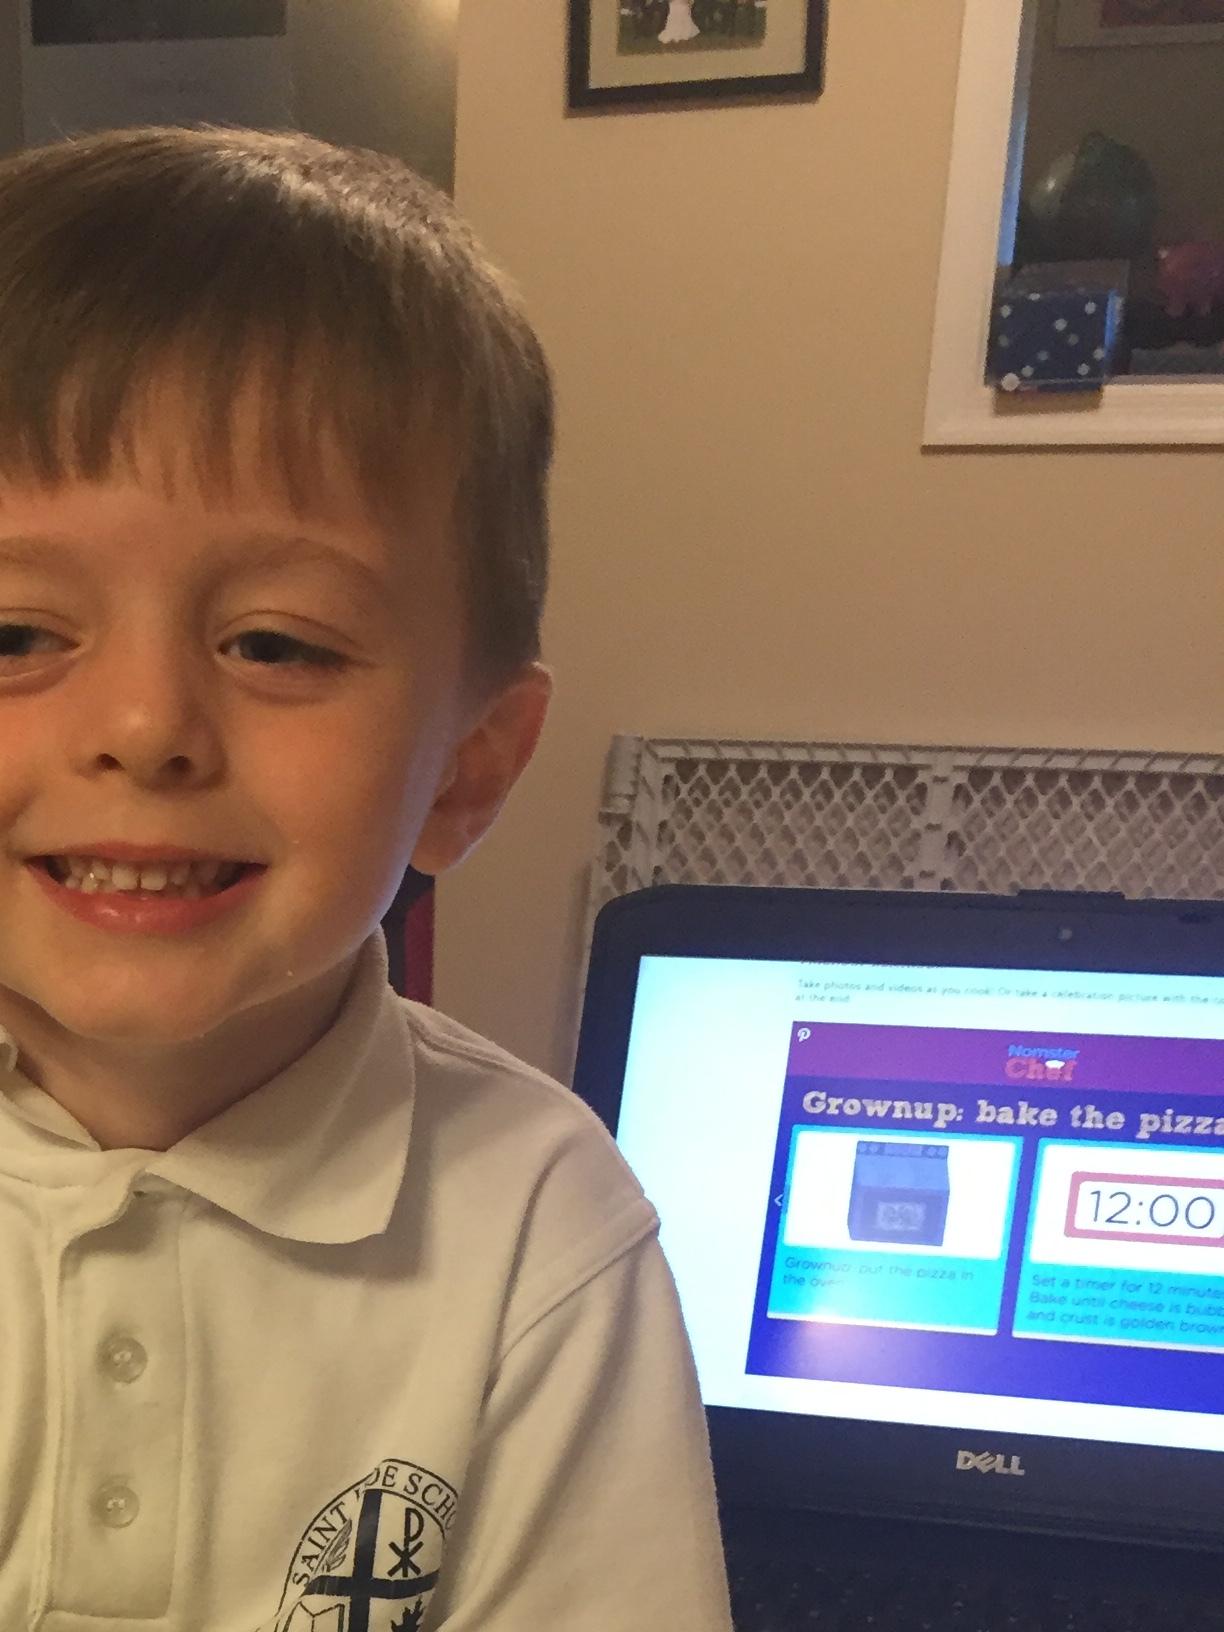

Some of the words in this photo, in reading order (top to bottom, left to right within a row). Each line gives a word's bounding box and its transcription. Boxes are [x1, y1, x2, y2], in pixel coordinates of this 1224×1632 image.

[797, 979, 821, 989] Take
[824, 980, 861, 992] photos
[865, 982, 885, 992] and
[888, 983, 923, 993] videos
[942, 986, 961, 997] you
[1051, 989, 1113, 1000] celebration
[1118, 991, 1158, 1003] picture
[1005, 1056, 1077, 1081] Chef
[802, 1090, 964, 1128] Grownup:
[975, 1099, 1058, 1127] bake
[1069, 1104, 1126, 1131] the
[1090, 1189, 1216, 1230] 12:00
[782, 1273, 807, 1287] the
[858, 1263, 885, 1277] put
[888, 1264, 913, 1278] the
[916, 1268, 956, 1281] pizza
[961, 1269, 975, 1281] in
[1032, 1274, 1057, 1288] Set
[1060, 1278, 1071, 1289] a
[1075, 1278, 1116, 1291] timer
[1120, 1280, 1144, 1294] for
[1148, 1282, 1164, 1295] 12
[1029, 1291, 1068, 1305] Bake
[1071, 1294, 1106, 1308] until
[1108, 1297, 1166, 1313] cheese
[1168, 1301, 1182, 1314] is
[1027, 1309, 1057, 1322] and
[1060, 1313, 1099, 1326] crust
[1103, 1314, 1116, 1328] is
[1119, 1315, 1175, 1331] golden
[956, 1450, 1025, 1476] DELL
[291, 1500, 353, 1588] SAINT
